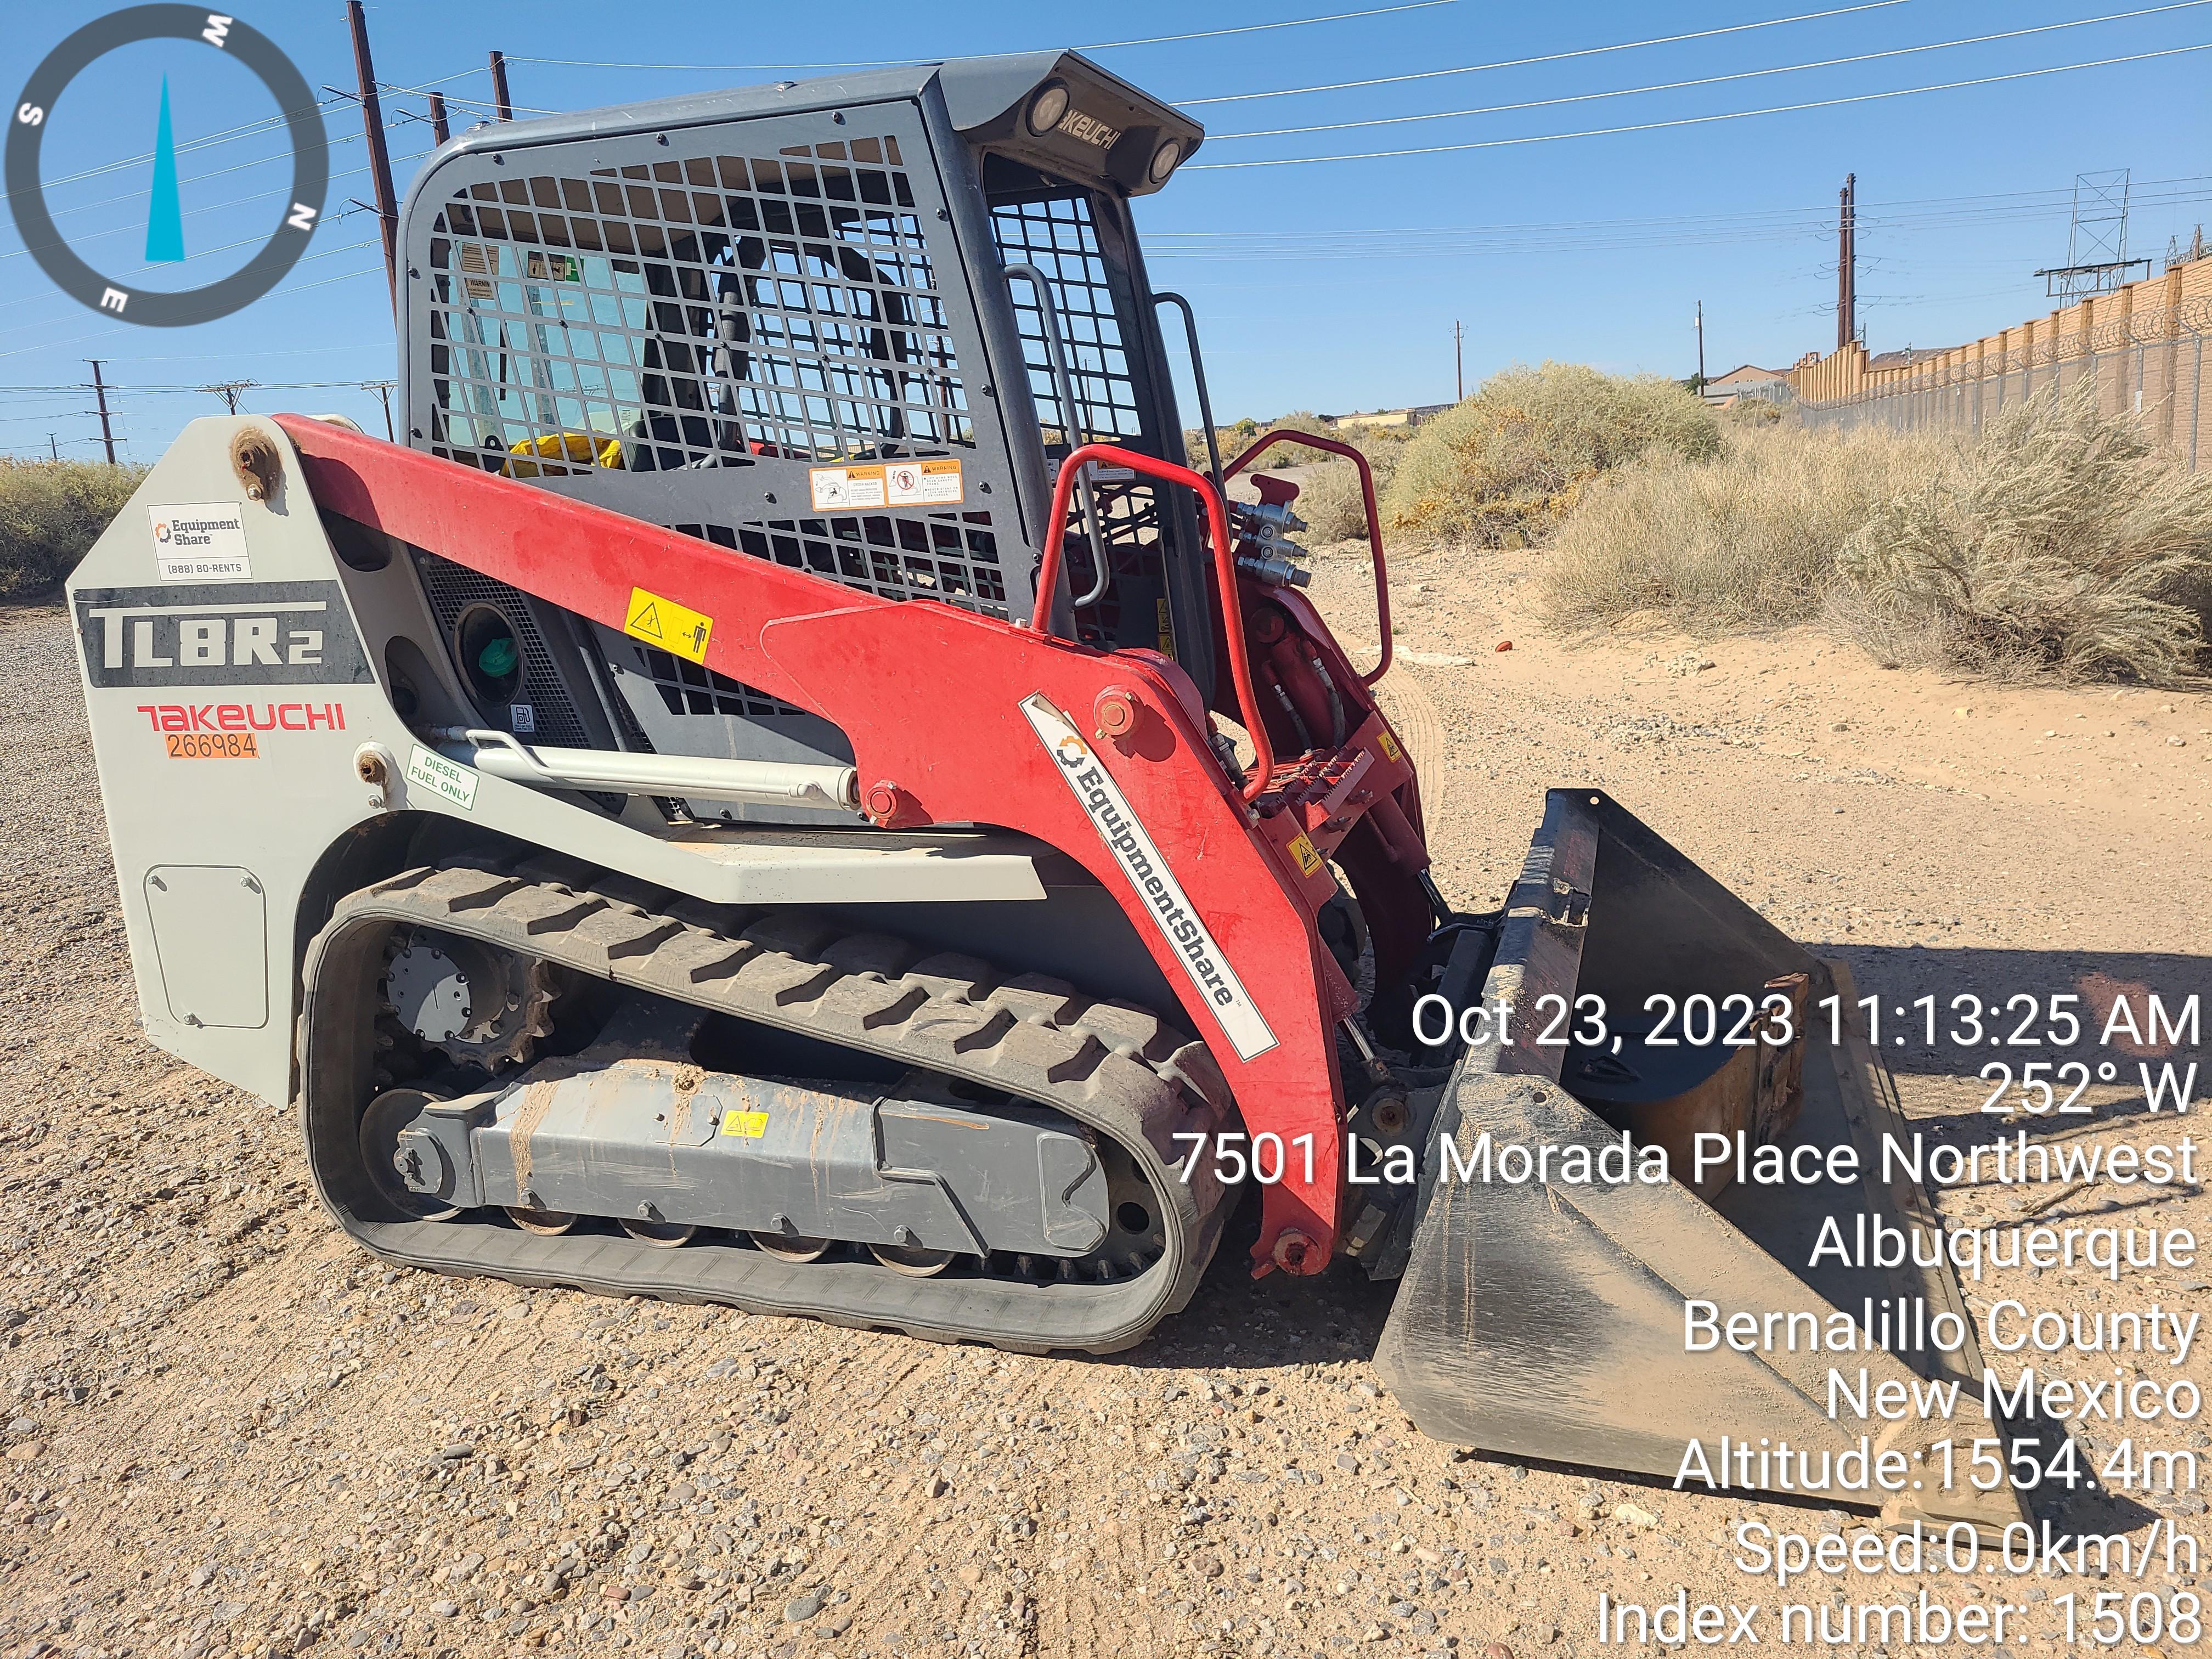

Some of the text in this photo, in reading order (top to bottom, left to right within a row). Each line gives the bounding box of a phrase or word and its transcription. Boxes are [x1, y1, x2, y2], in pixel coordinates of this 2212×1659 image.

[171, 518, 240, 534] Equipment
[174, 533, 211, 545] Share
[168, 563, 242, 574] (888) 80-RENTS
[167, 733, 257, 758] 266984
[425, 756, 462, 783] DIESEL
[411, 766, 470, 802] FUEL ONLY
[1076, 766, 1233, 1006] EquipmentShare
